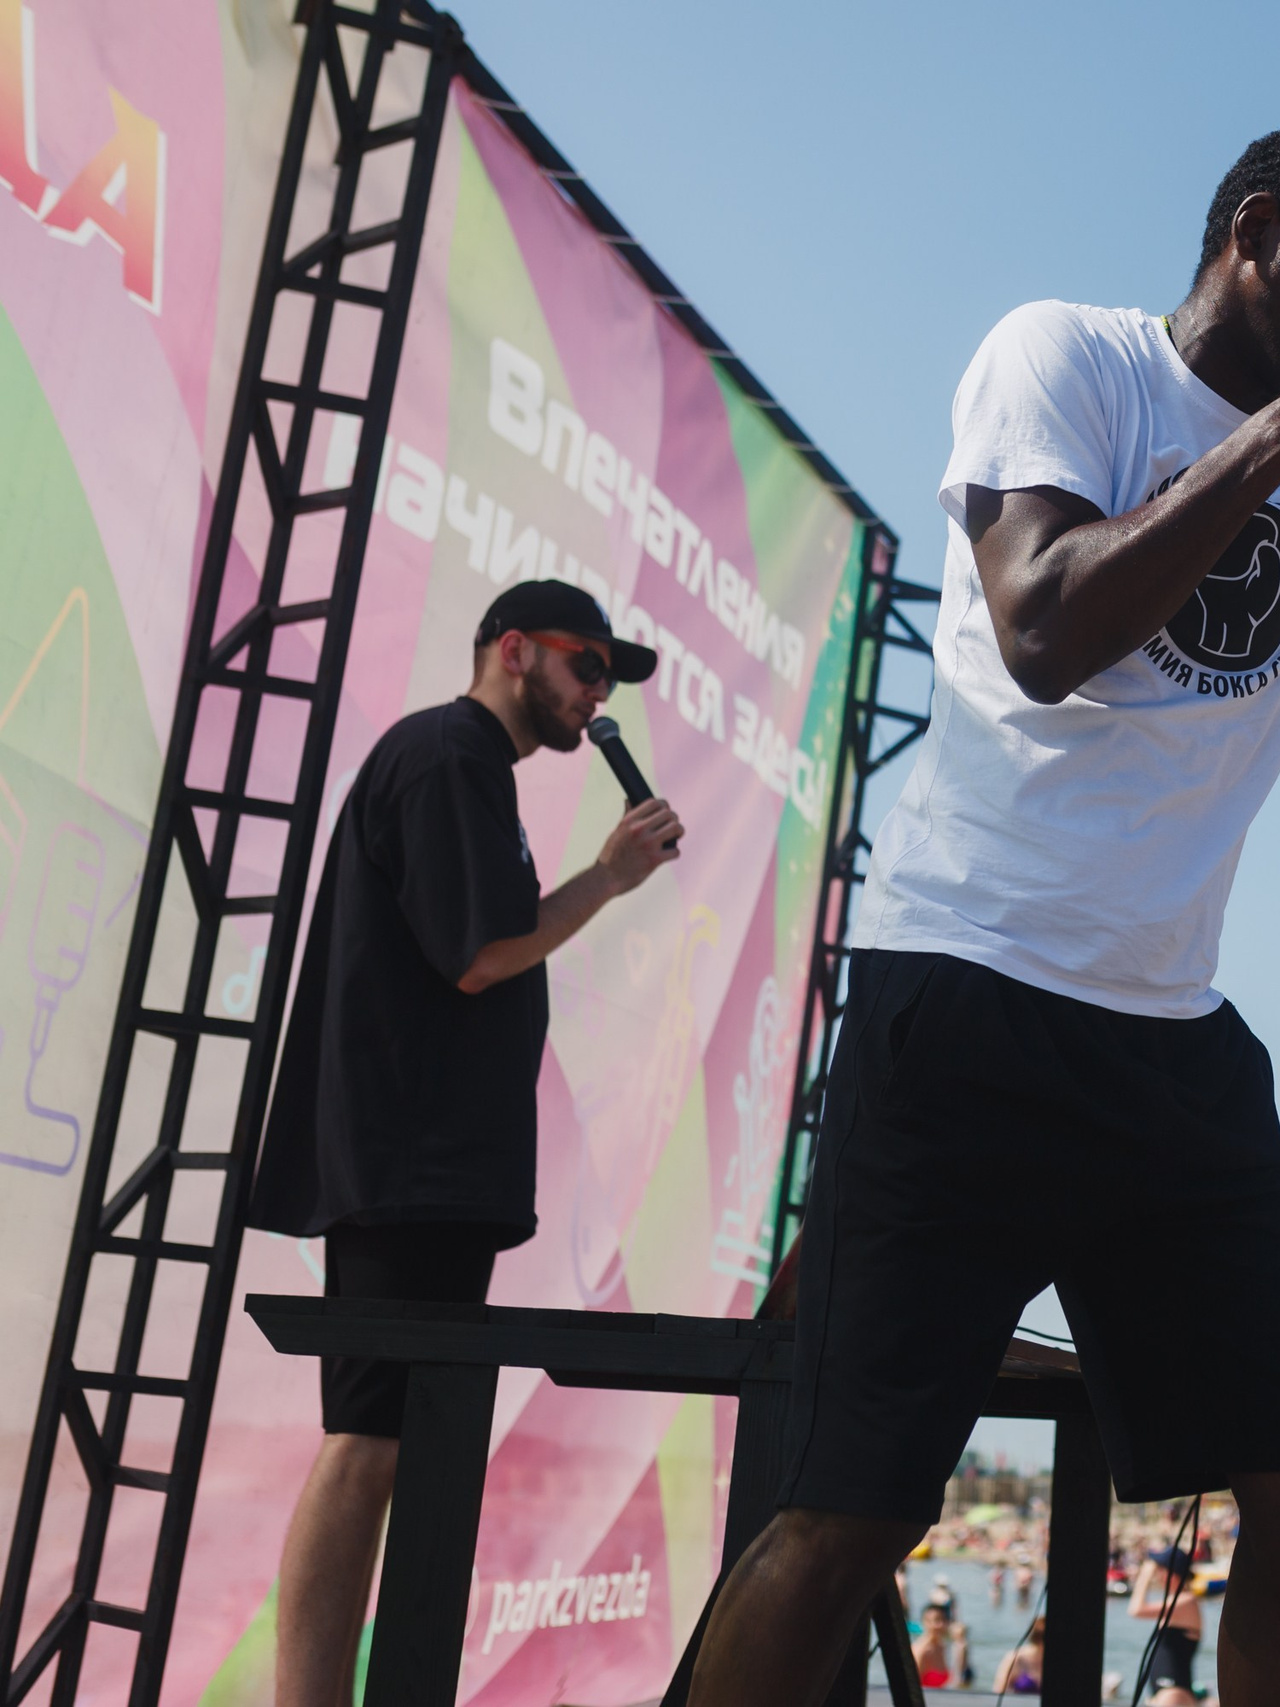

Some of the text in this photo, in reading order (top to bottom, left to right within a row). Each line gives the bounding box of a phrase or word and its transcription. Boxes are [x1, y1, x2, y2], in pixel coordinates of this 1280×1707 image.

[488, 336, 806, 692] Впечатления
[1142, 633, 1194, 688] МИЯ
[1197, 671, 1268, 699] БОКСА
[731, 693, 827, 832] здесь
[481, 1553, 651, 1655] parkzvezda
